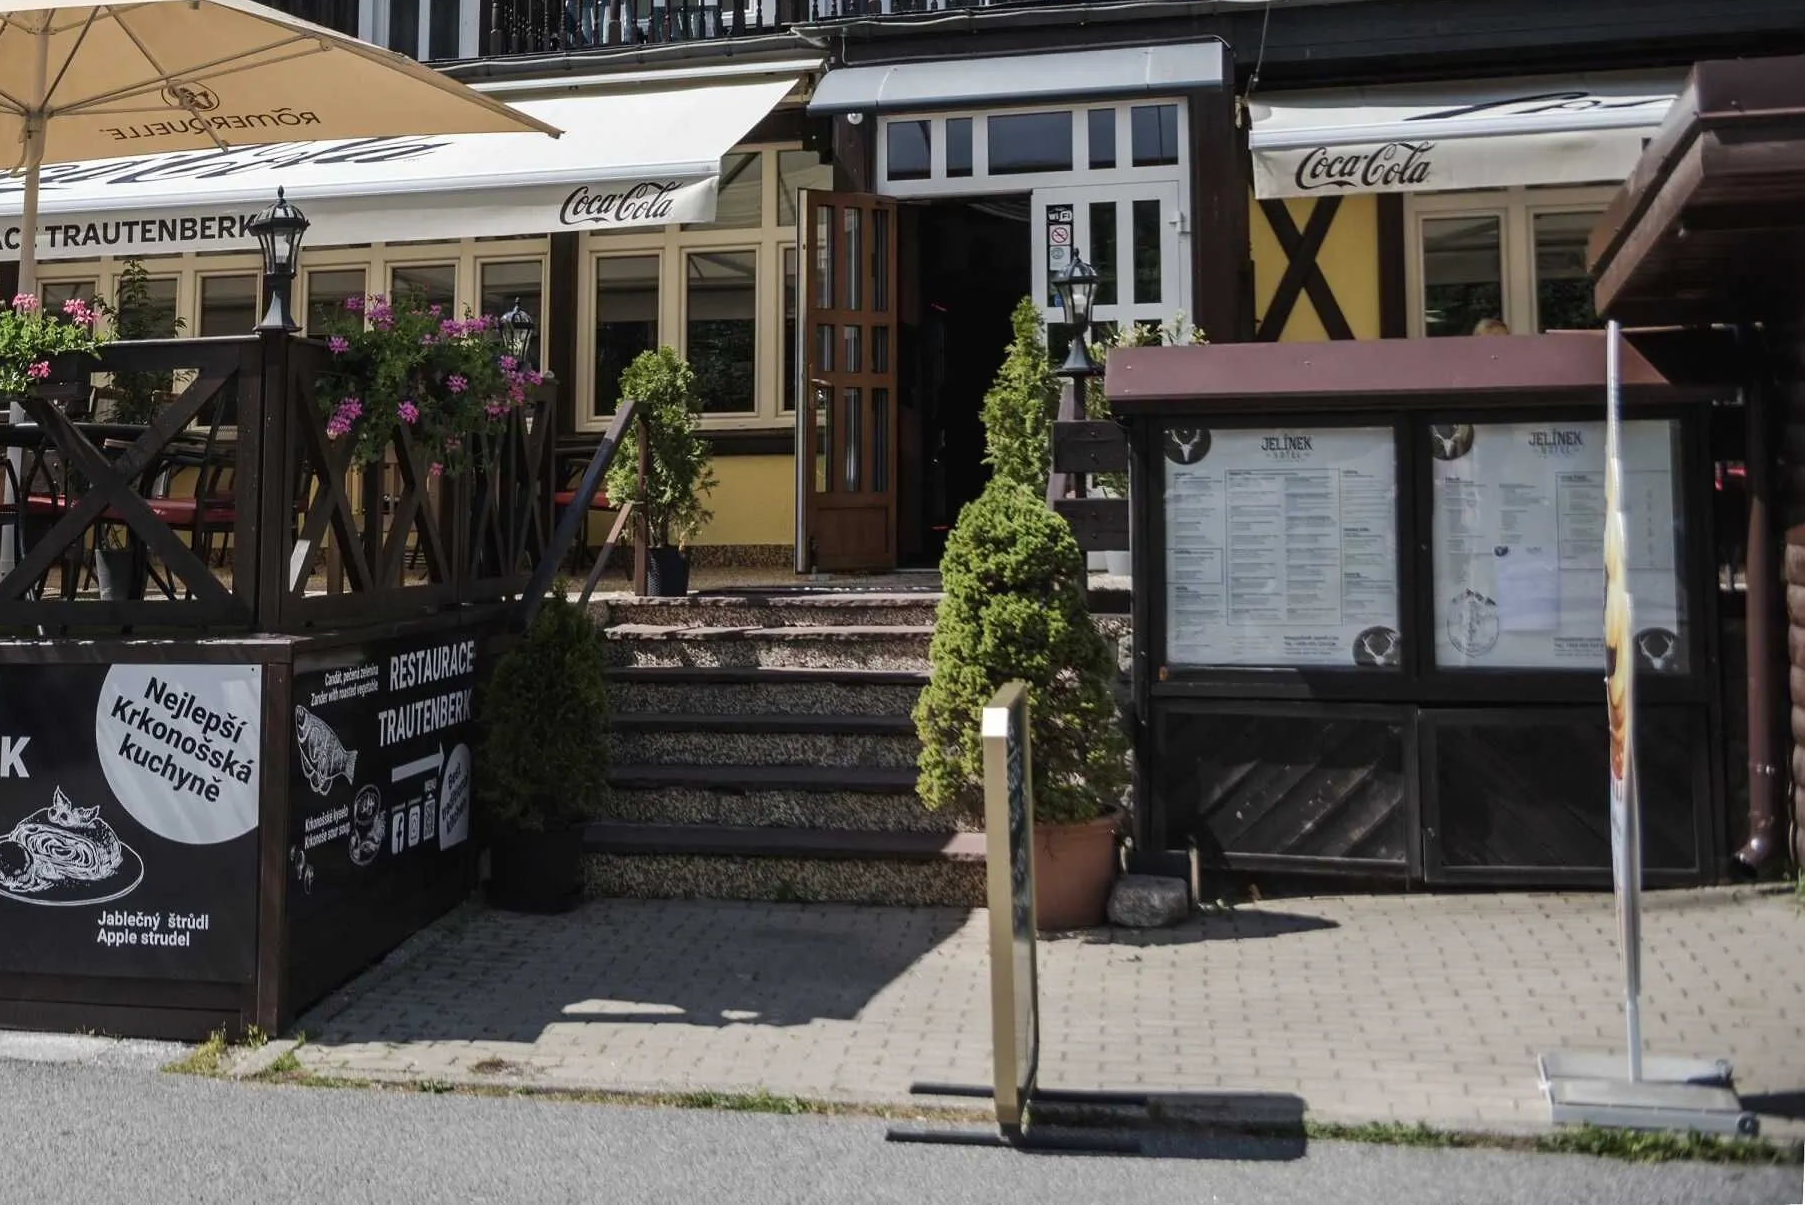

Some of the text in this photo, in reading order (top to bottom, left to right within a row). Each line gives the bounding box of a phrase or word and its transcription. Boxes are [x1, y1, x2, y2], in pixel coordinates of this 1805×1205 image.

[1295, 140, 1436, 190] Coca-Cola
[559, 181, 683, 226] Coca-Cola
[44, 213, 259, 248] TRAUTENBERK
[389, 640, 475, 692] RESTAURACE
[144, 676, 248, 744] Nejlepší
[378, 689, 473, 747] TRAUTENBERK
[111, 695, 255, 784] Krkonošská
[118, 732, 222, 803] kuchyně
[96, 927, 191, 947] Apple strudel
[97, 910, 209, 931] Jablečný štrůdl
